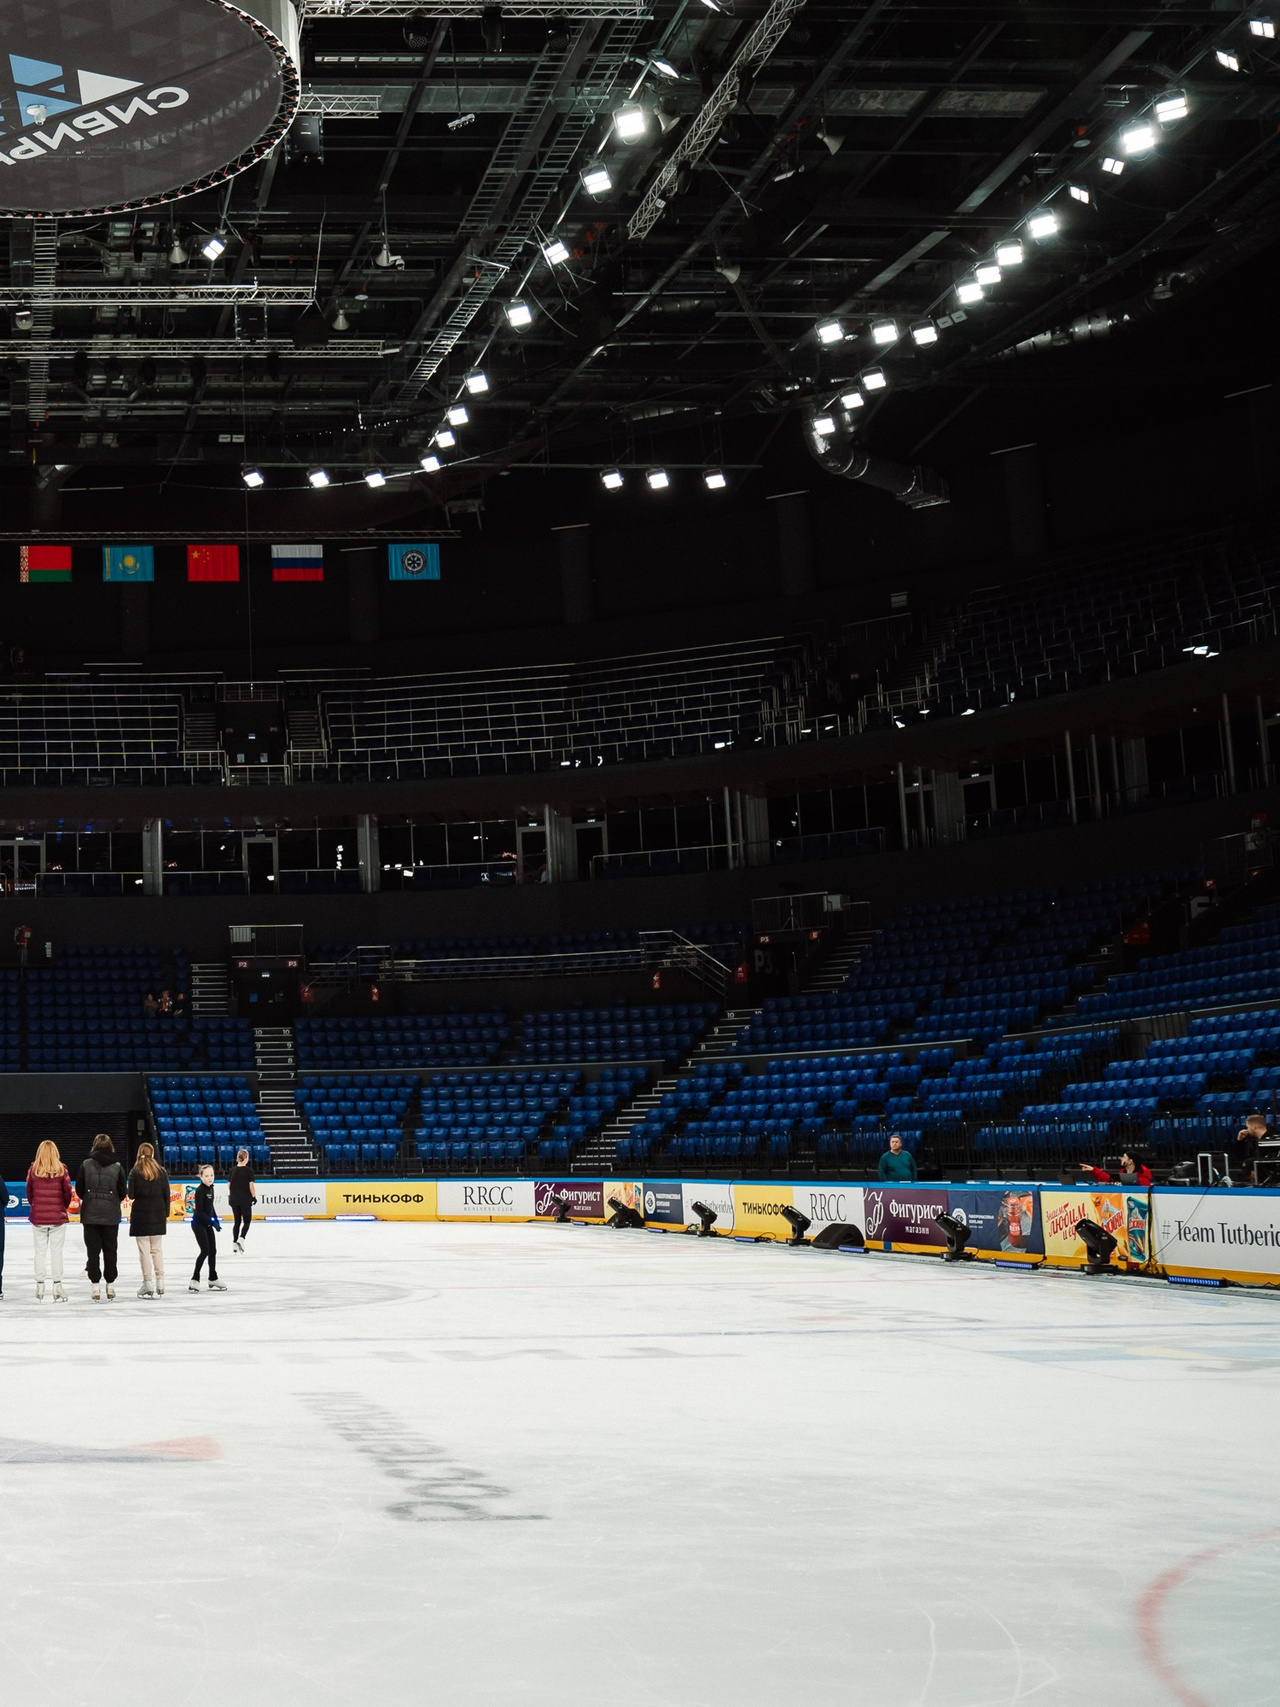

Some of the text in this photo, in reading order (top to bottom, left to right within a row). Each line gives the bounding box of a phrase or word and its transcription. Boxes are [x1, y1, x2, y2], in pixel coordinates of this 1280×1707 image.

[260, 1194, 321, 1205] Tutberidze
[343, 1194, 424, 1204] ТИНЬКОФФ
[463, 1186, 513, 1205] RRCC
[560, 1189, 601, 1205] Фигурист
[810, 1193, 847, 1222] RRCC
[905, 1226, 930, 1235] магазин
[1175, 1220, 1215, 1243] Team
